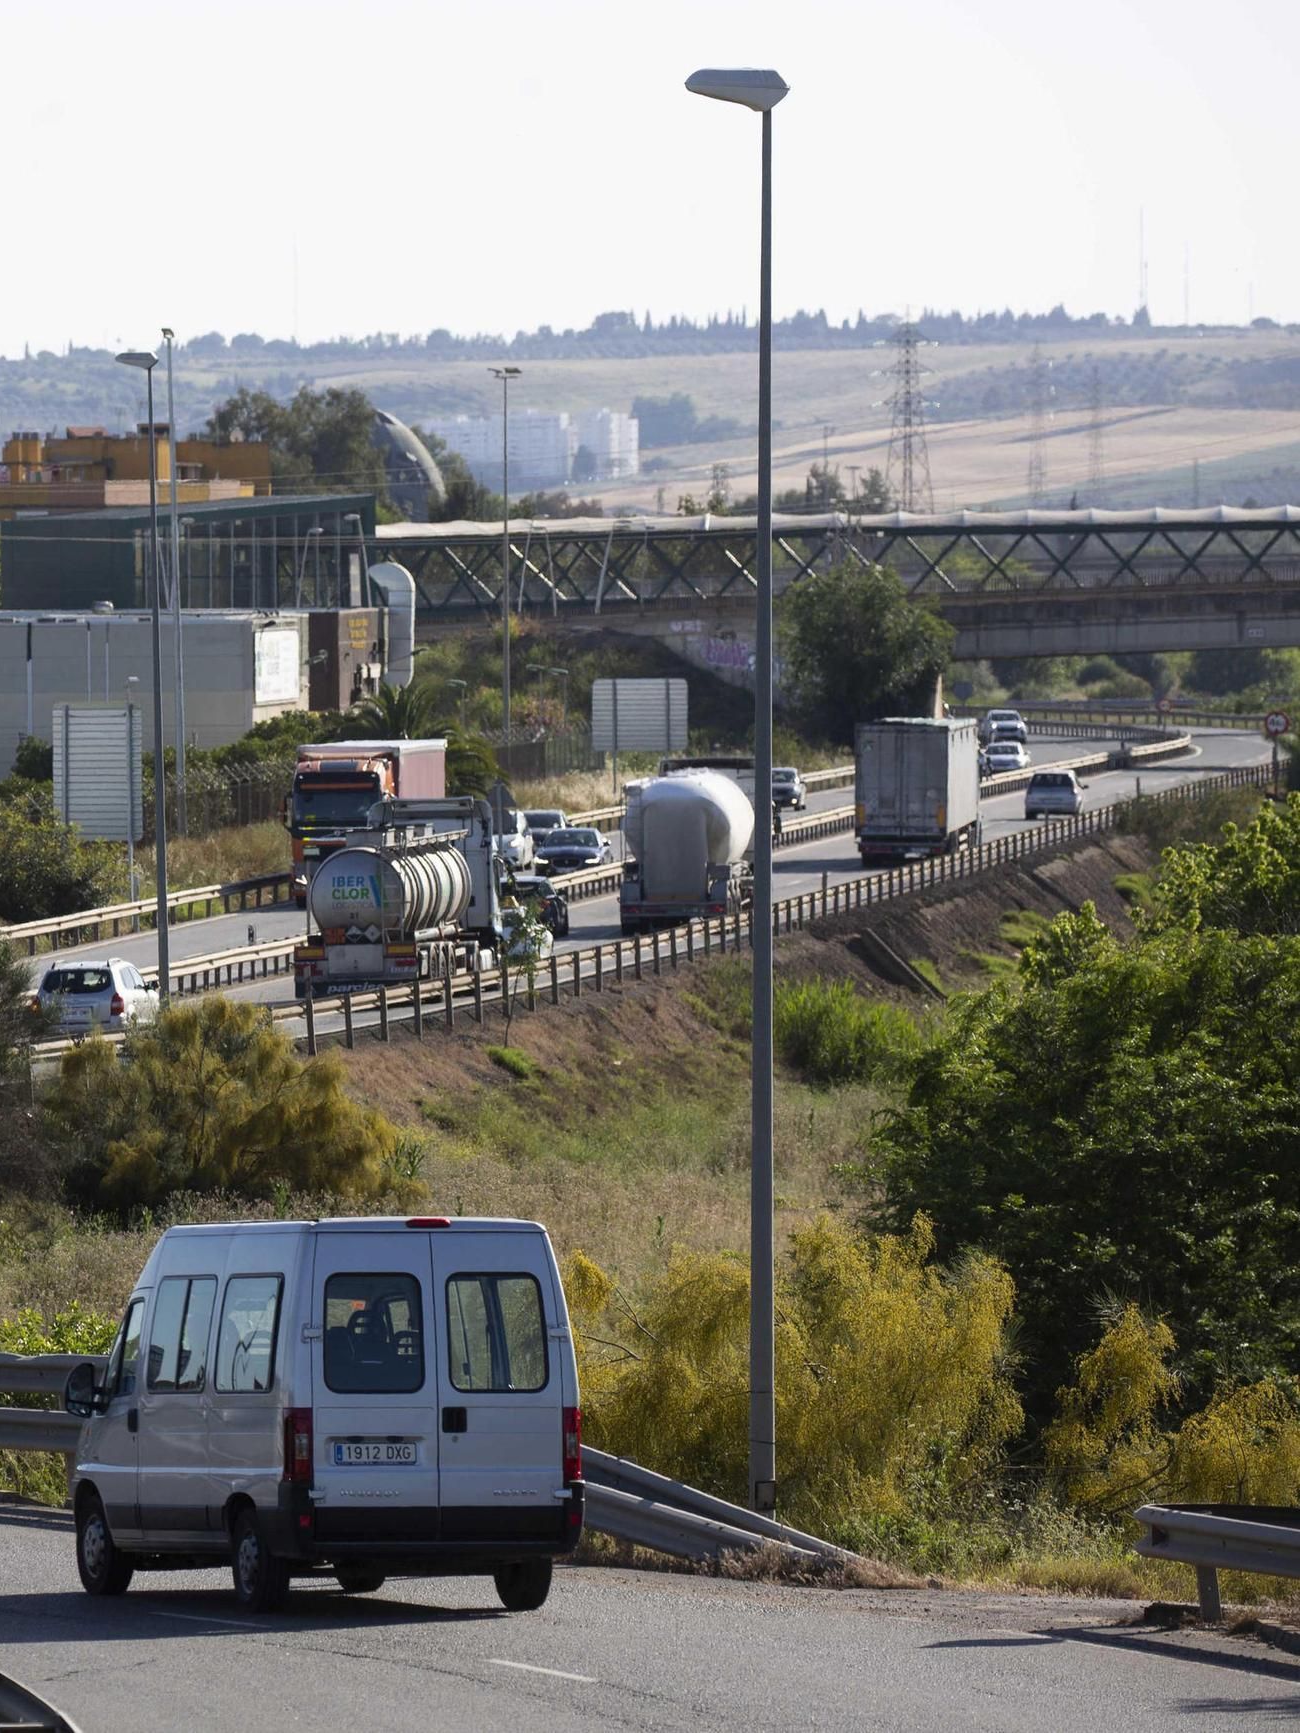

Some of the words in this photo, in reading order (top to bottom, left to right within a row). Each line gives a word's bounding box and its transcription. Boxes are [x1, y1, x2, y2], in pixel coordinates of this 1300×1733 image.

[332, 876, 365, 888] IBER
[332, 888, 370, 900] CLOR
[347, 1445, 381, 1460] 1912
[386, 1445, 412, 1460] DXG
